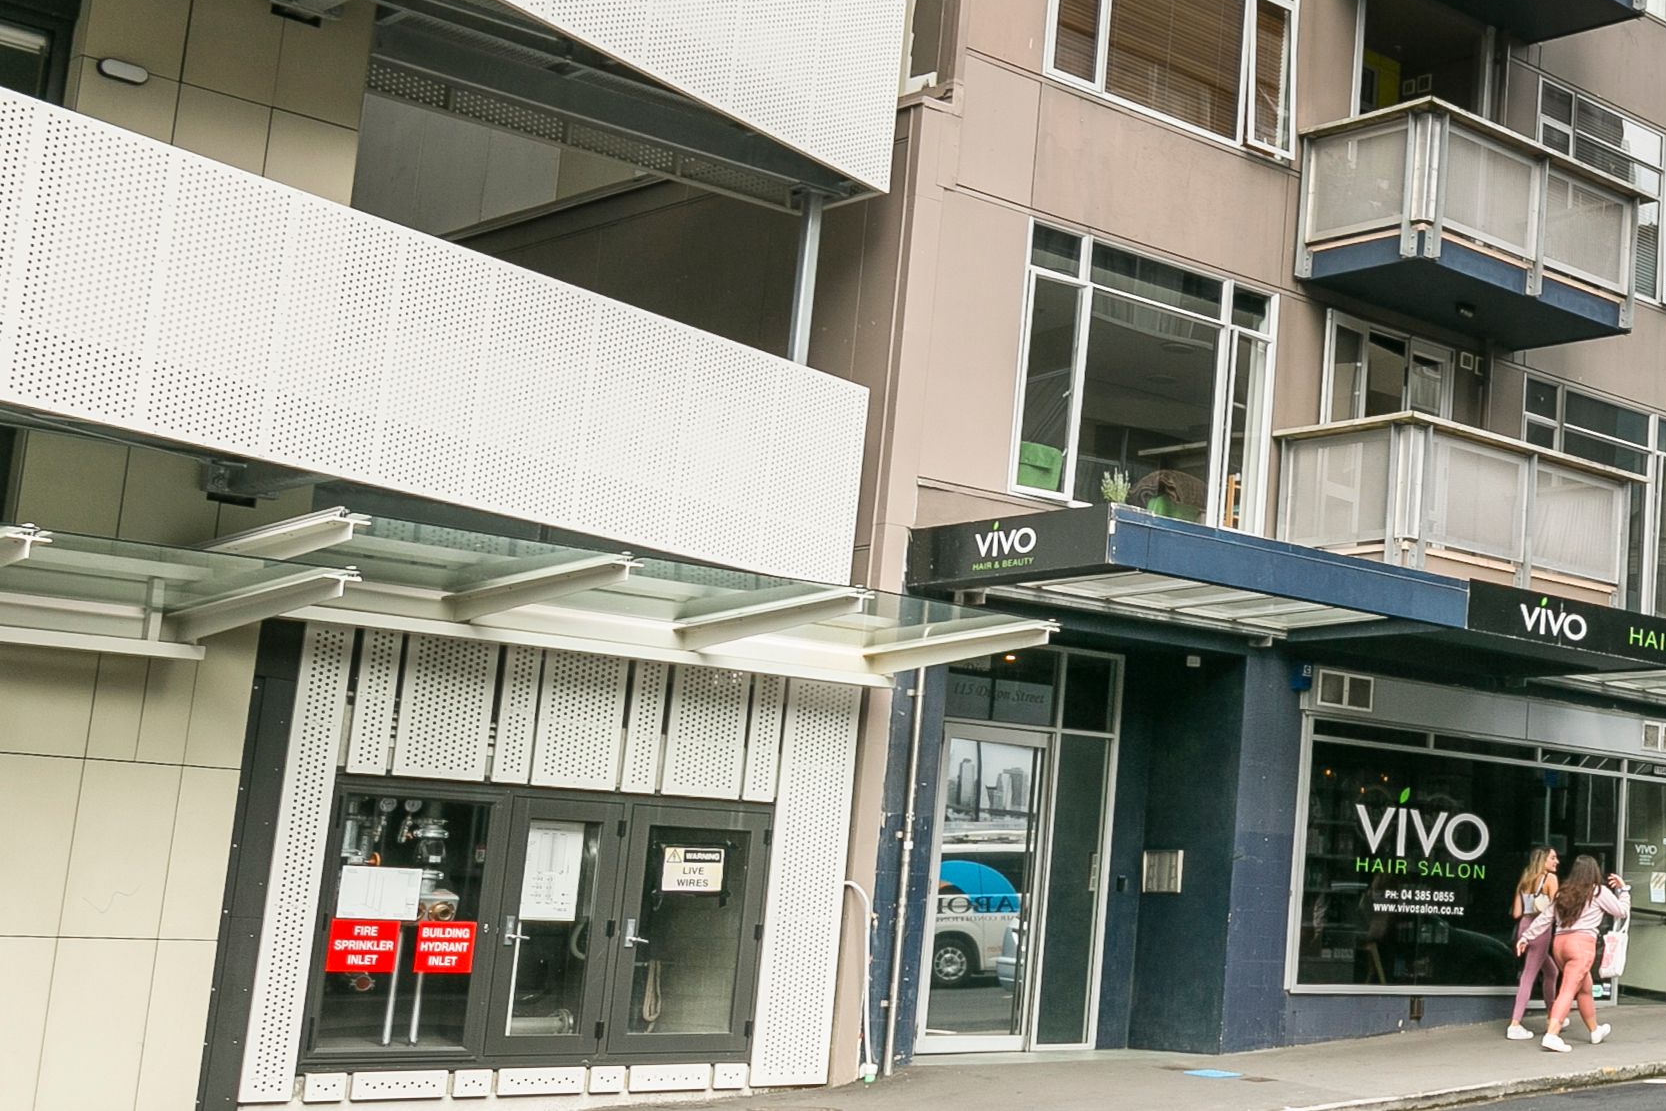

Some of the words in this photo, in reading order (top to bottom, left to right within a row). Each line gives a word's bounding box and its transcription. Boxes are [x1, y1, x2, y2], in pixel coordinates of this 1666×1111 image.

[975, 521, 1037, 558] VIVO
[972, 561, 992, 571] HAIR
[994, 560, 1000, 569] &
[1002, 557, 1035, 568] BEAUTY
[1520, 597, 1587, 640] VIVO
[1012, 687, 1046, 704] Street
[1355, 787, 1490, 861] VIVO
[685, 852, 720, 861] WARNING
[682, 866, 704, 875] LIVE
[1356, 857, 1407, 874] HAIR
[1418, 860, 1486, 879] SALON
[676, 878, 709, 888] WIRES
[1384, 890, 1399, 899] PH:
[1401, 890, 1412, 899] 04
[1414, 890, 1431, 901] 385
[1433, 891, 1455, 902] 0855
[1373, 903, 1464, 915] www.vivosalon.co.nz
[354, 926, 379, 936] FIRE
[422, 928, 470, 938] BUILDING
[333, 940, 394, 951] SPRINKLER
[420, 942, 469, 952] HYDRANT
[346, 954, 379, 965] INLET
[428, 956, 458, 966] INLET
